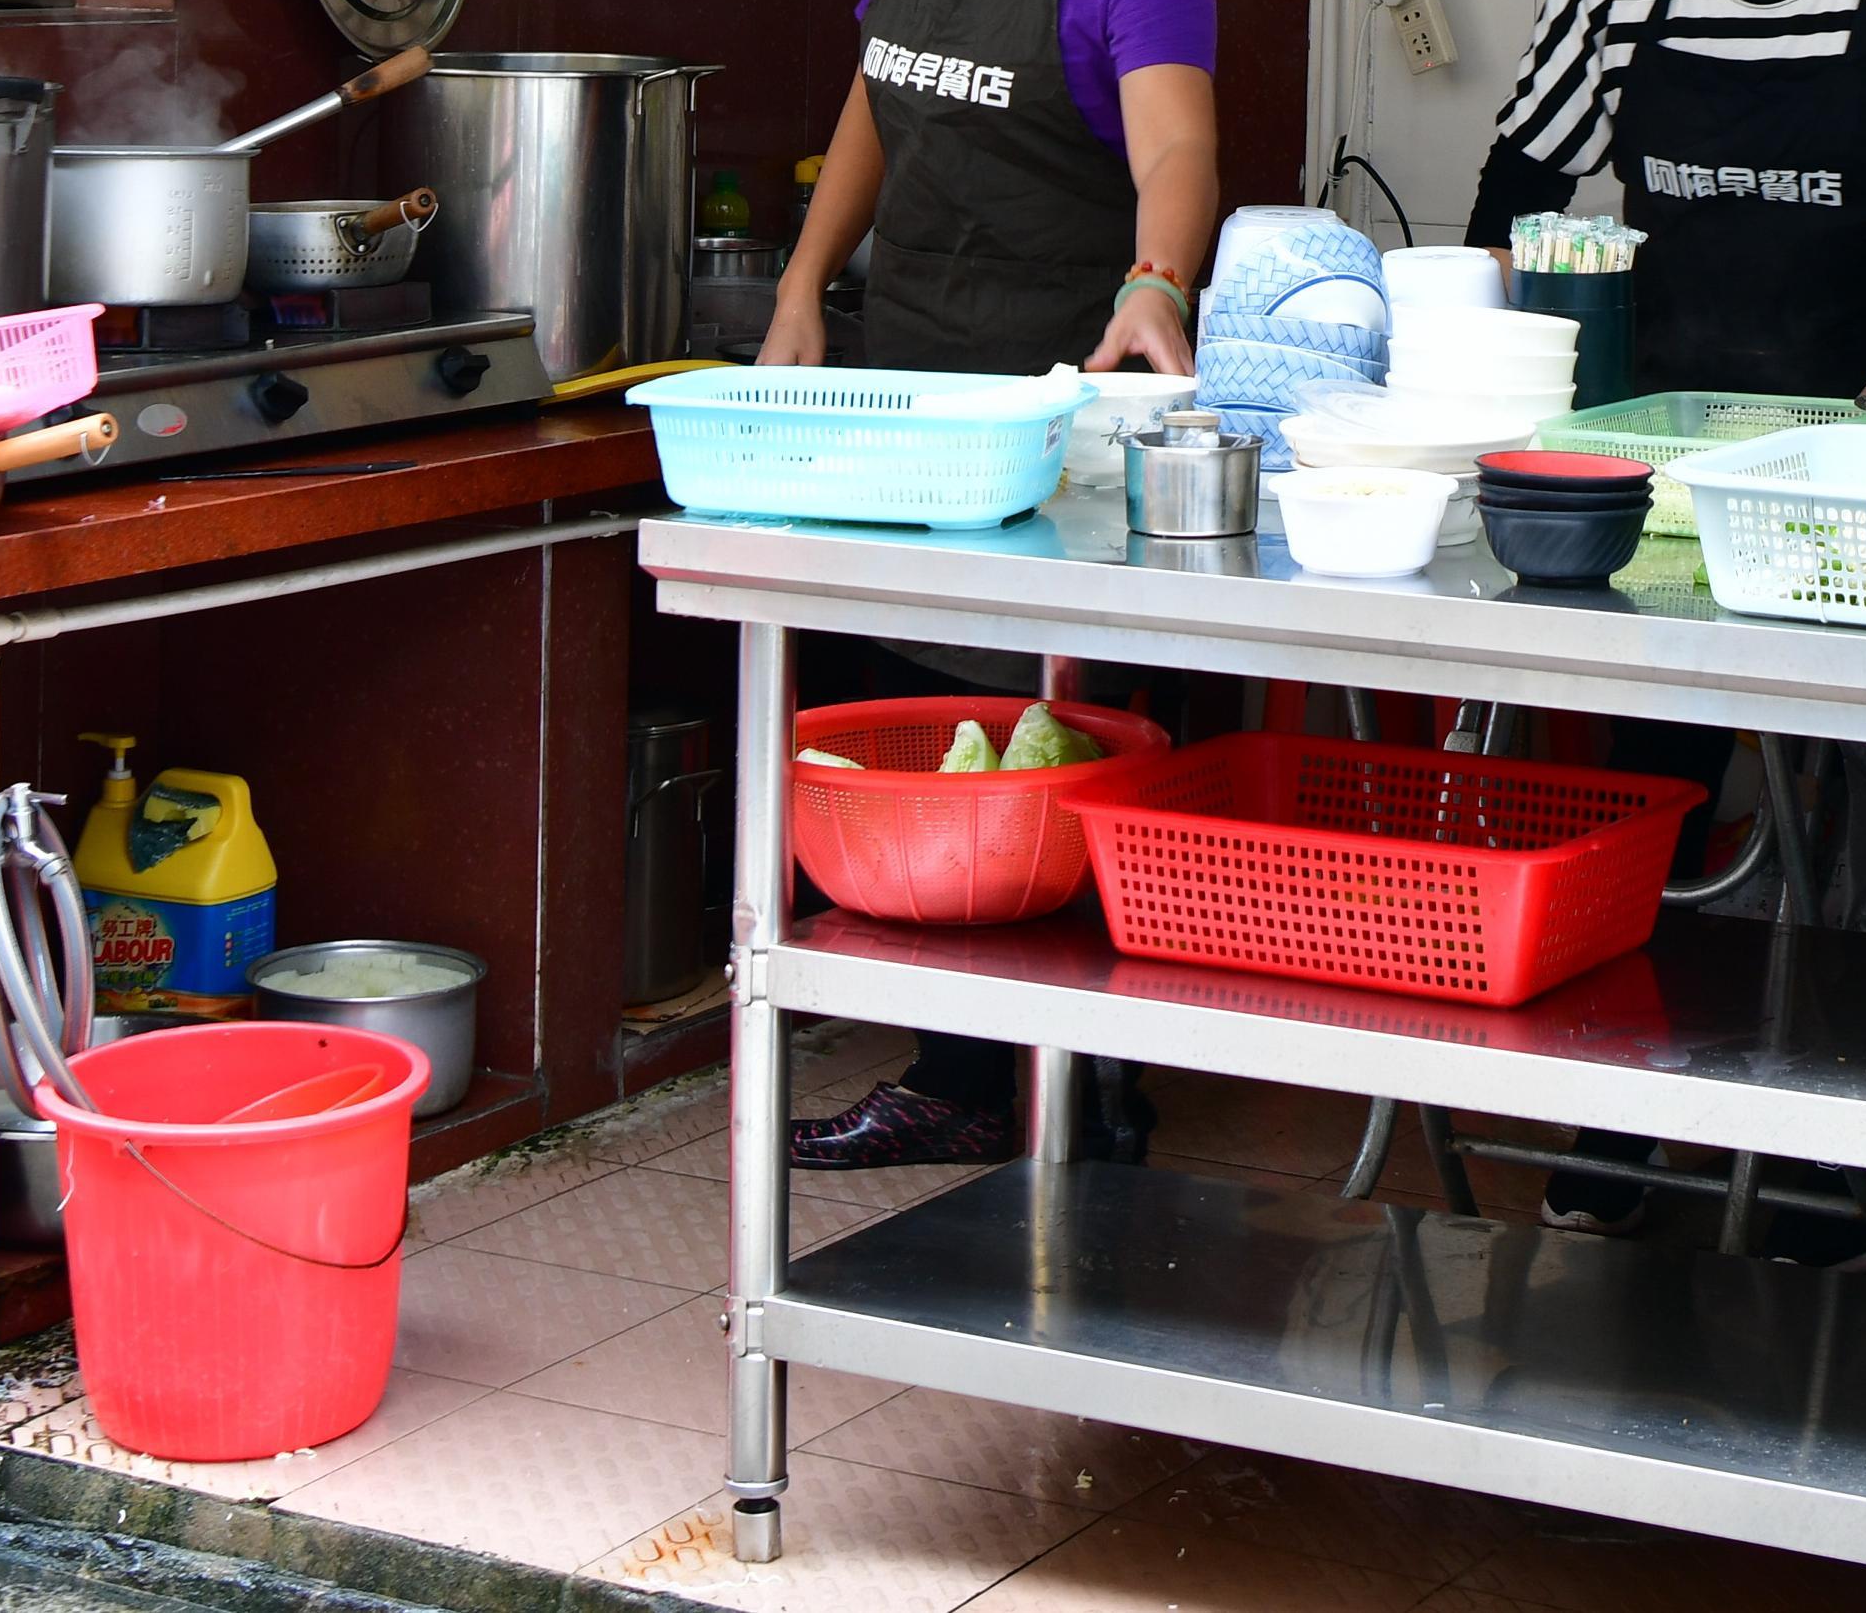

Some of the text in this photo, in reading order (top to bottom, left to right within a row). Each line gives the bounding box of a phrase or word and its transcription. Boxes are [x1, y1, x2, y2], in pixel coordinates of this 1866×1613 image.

[863, 36, 1015, 109] 阿梅早餐店
[1643, 155, 1843, 208] 阿梅早餐店
[94, 937, 175, 964] LABOUR
